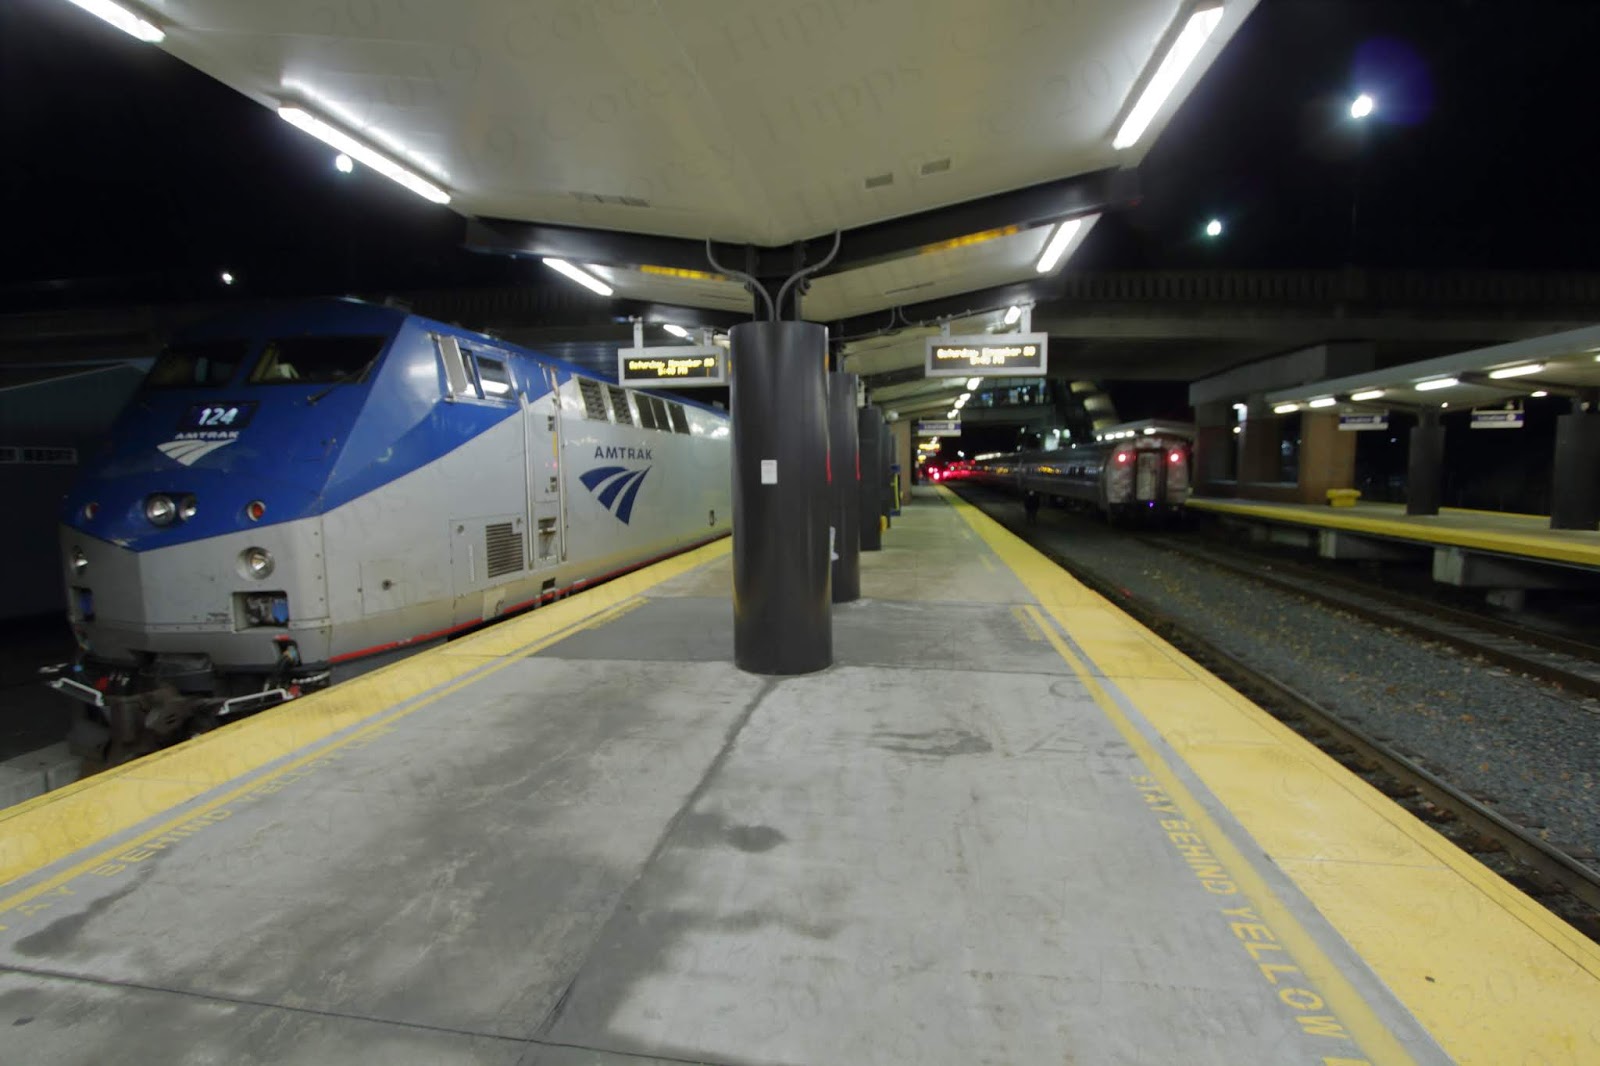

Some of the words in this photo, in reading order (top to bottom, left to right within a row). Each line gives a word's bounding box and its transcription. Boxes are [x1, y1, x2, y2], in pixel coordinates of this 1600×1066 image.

[199, 407, 239, 425] 124
[174, 430, 240, 440] AMTRAK
[594, 445, 653, 461] AMTRAK
[89, 809, 232, 877] BEHIND
[1131, 774, 1179, 814] STAY
[1159, 818, 1238, 895] BEHIND
[1220, 906, 1349, 1039] YELLOW
